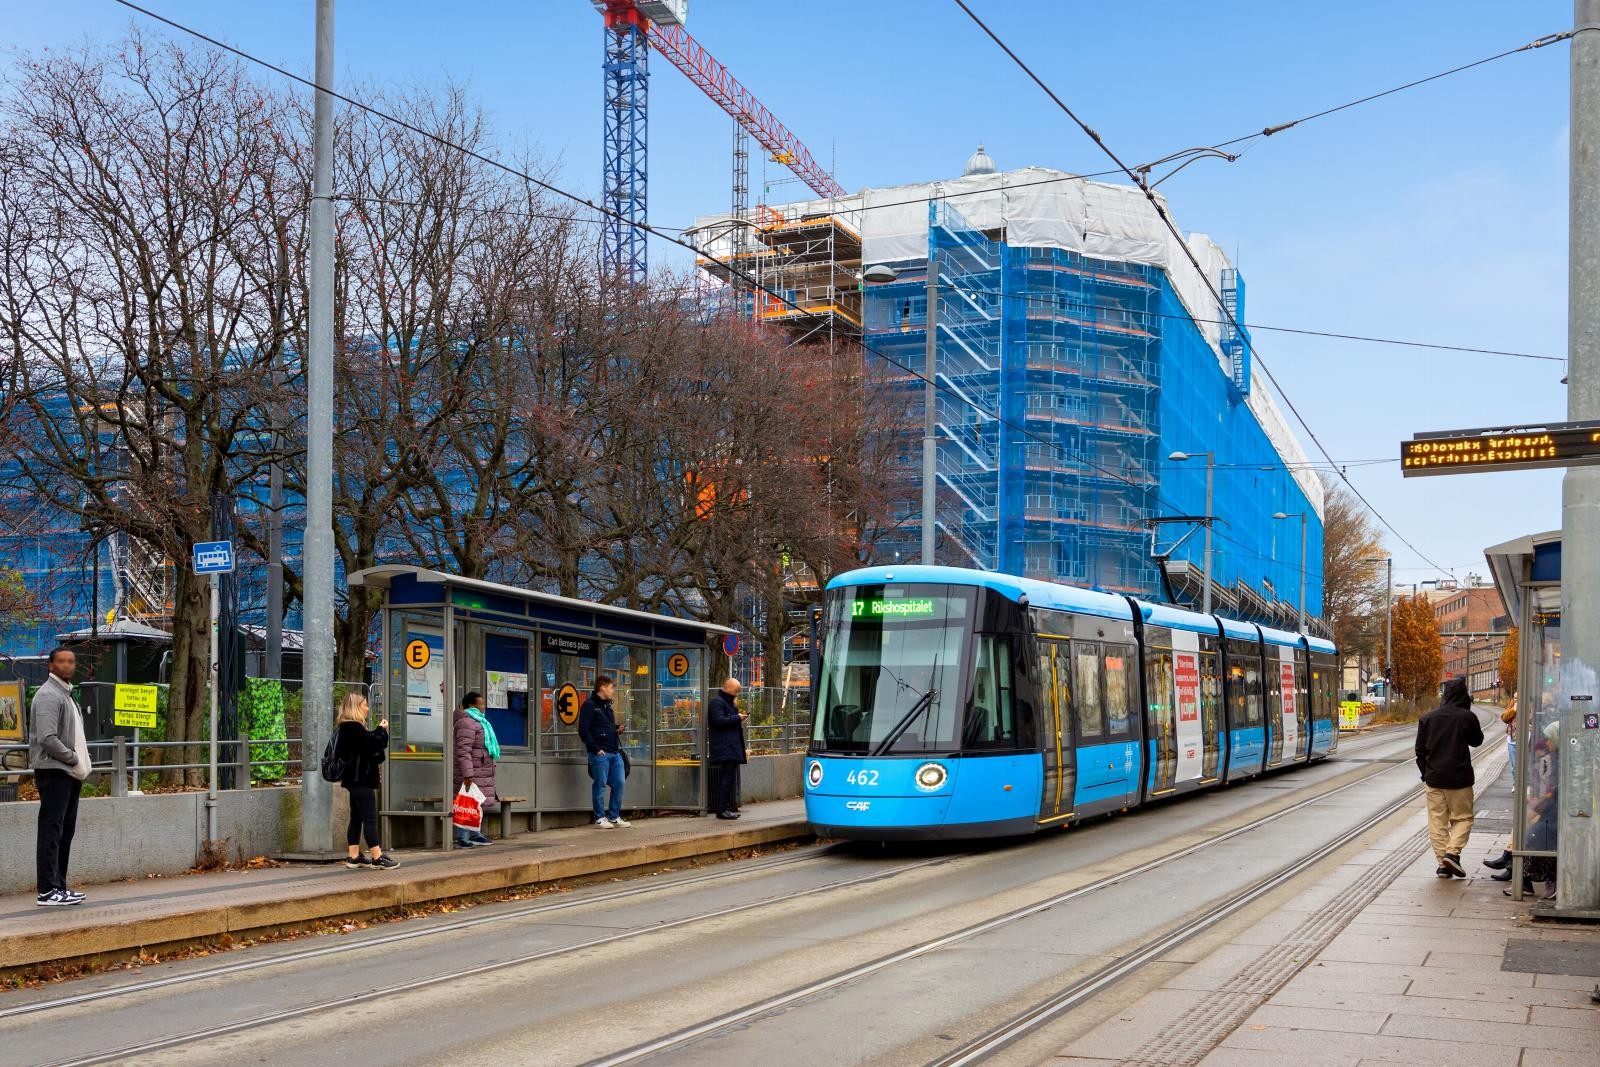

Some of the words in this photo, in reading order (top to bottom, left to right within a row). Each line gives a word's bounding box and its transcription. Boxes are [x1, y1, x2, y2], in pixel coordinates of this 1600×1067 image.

[852, 601, 865, 616] 17
[871, 600, 933, 616] Rikshospitalet
[547, 636, 558, 646] Carl
[558, 638, 577, 648] Berners
[577, 641, 590, 650] plass
[412, 645, 423, 663] E
[674, 658, 683, 672] E
[846, 769, 879, 786] 462
[846, 801, 871, 811] CAF
